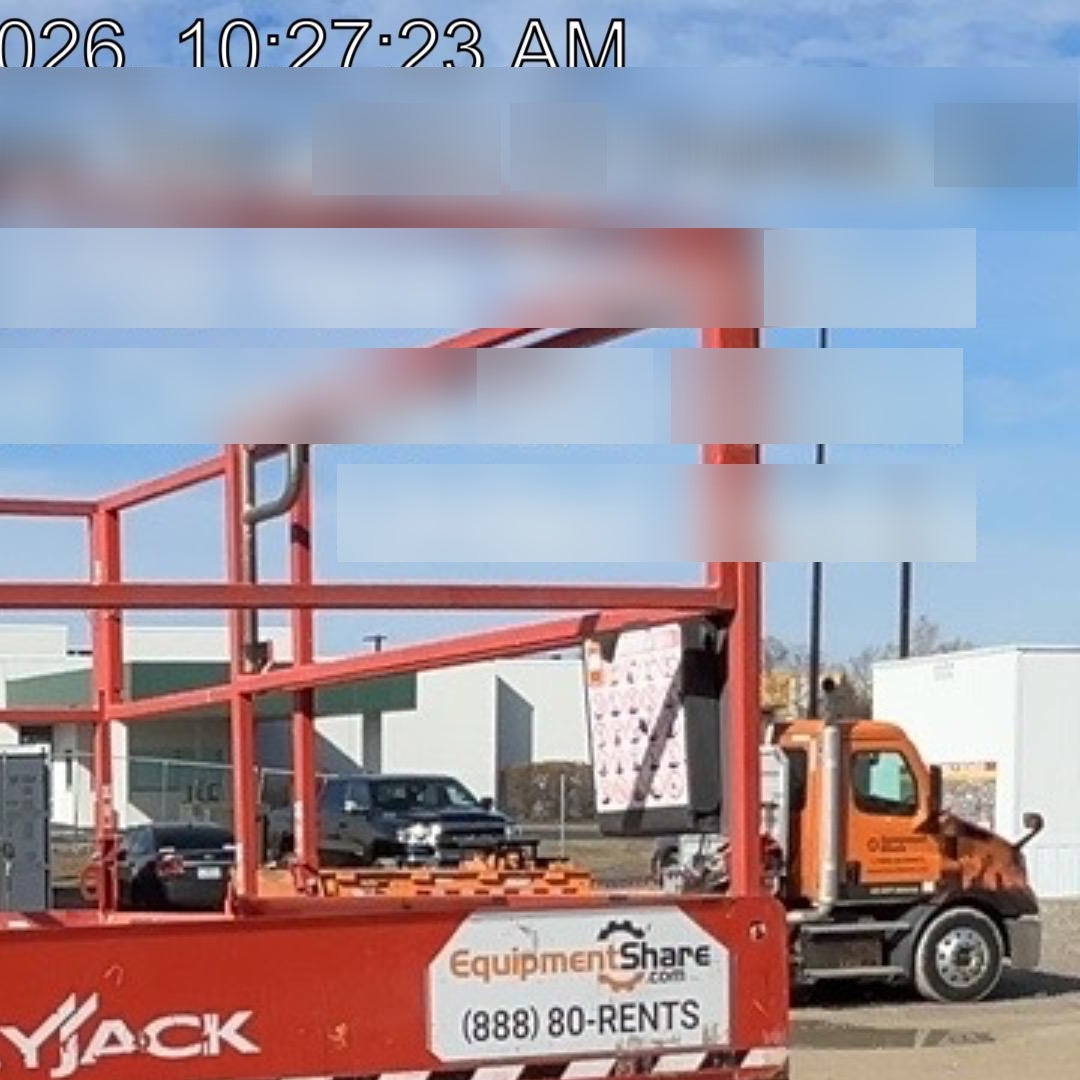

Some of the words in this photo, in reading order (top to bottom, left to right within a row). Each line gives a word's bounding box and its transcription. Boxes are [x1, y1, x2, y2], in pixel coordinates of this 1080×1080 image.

[448, 941, 712, 983] EquipmentShare
[461, 1006, 539, 1044] (888)
[547, 999, 701, 1037] 80-RENTS
